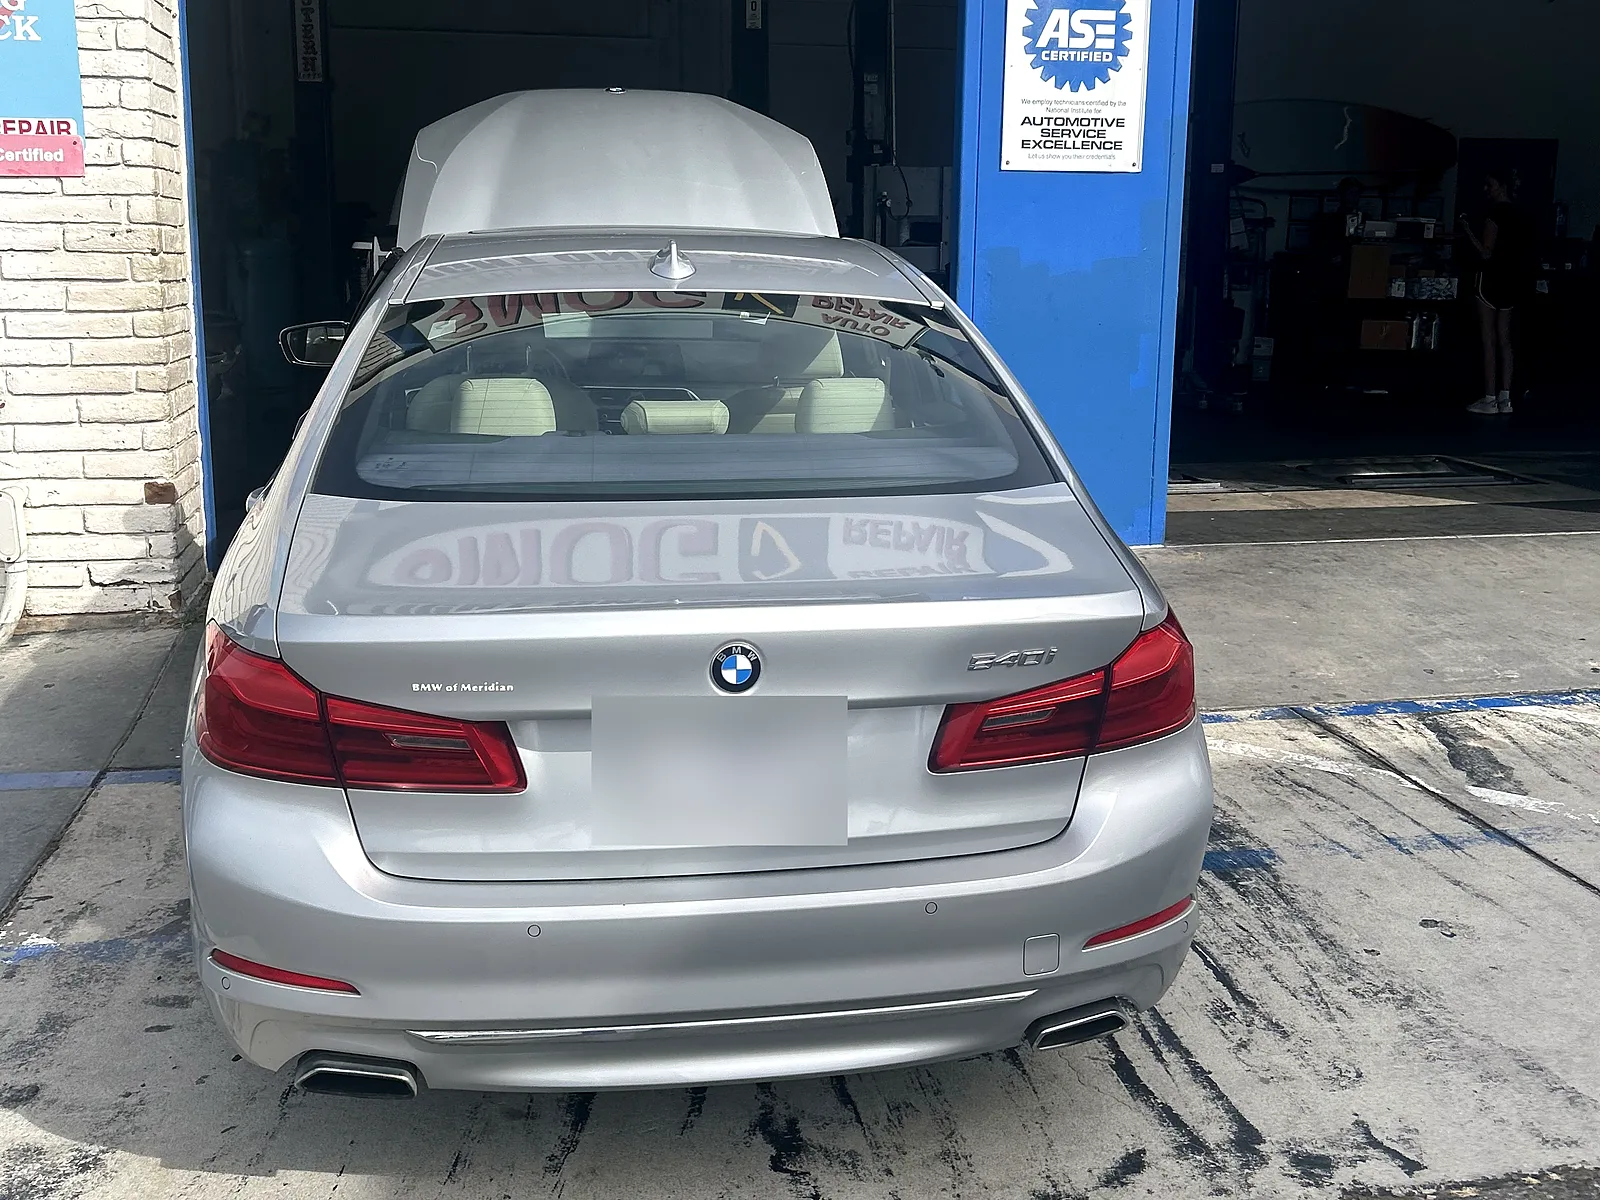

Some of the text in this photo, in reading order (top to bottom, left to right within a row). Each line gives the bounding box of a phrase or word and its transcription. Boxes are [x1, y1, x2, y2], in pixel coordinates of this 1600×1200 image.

[1035, 8, 1117, 49] ASE
[1041, 50, 1113, 62] CERTIFIED
[1110, 100, 1117, 108] by
[0, 119, 72, 135] EPAIR
[1020, 116, 1126, 128] AUTOMOTIVE
[1040, 128, 1107, 139] SERVICE
[1020, 139, 1123, 151] EXCELLENCE
[717, 647, 758, 662] BMW
[412, 682, 514, 692] BMW of Meridian
